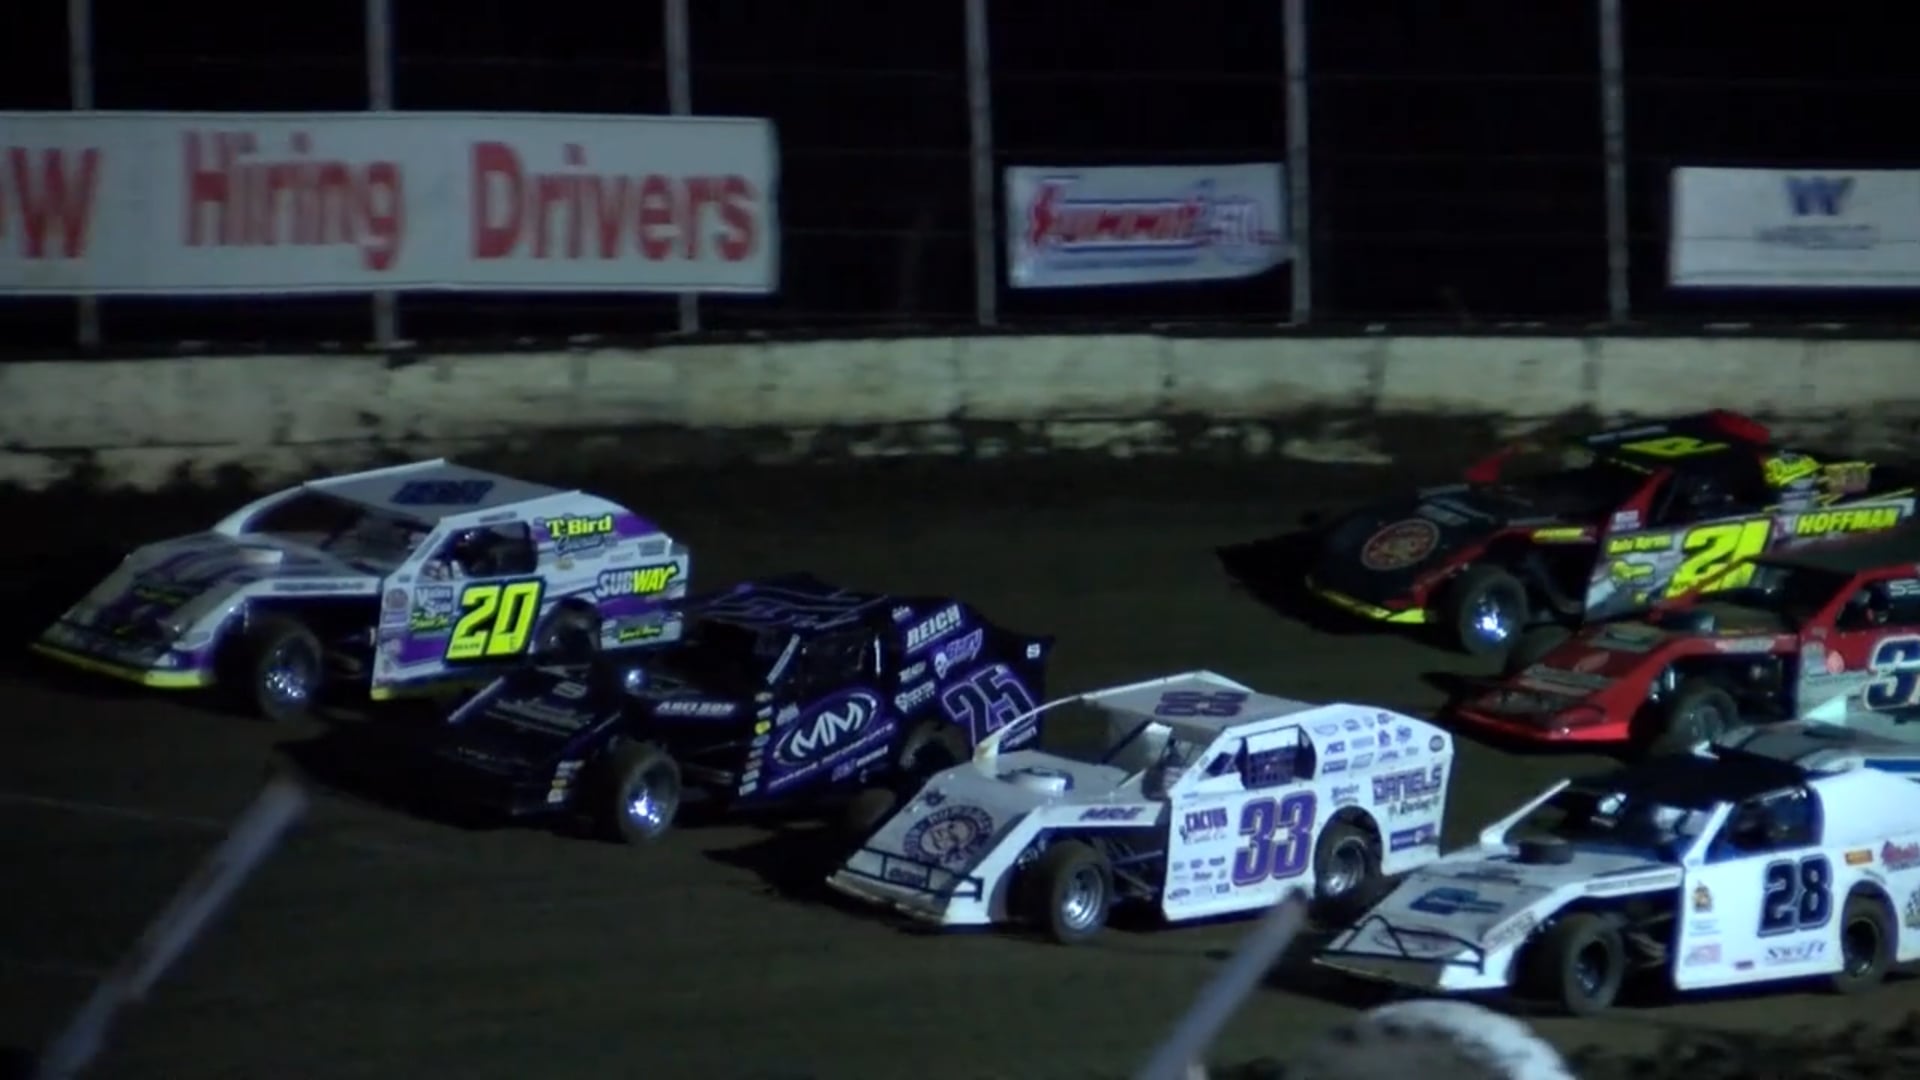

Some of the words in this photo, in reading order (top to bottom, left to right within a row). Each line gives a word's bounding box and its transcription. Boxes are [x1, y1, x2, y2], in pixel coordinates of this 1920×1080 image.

[0, 146, 100, 261] W
[182, 131, 404, 272] Hiring
[470, 141, 758, 262] Drivers
[1666, 520, 1771, 598] 21
[1797, 508, 1900, 536] HOFFMAN
[447, 581, 541, 659] 20
[597, 564, 679, 599] SUBWAY
[906, 604, 961, 648] REICH
[942, 664, 1038, 750] 25
[1232, 789, 1318, 887] 33
[1757, 855, 1833, 937] 28
